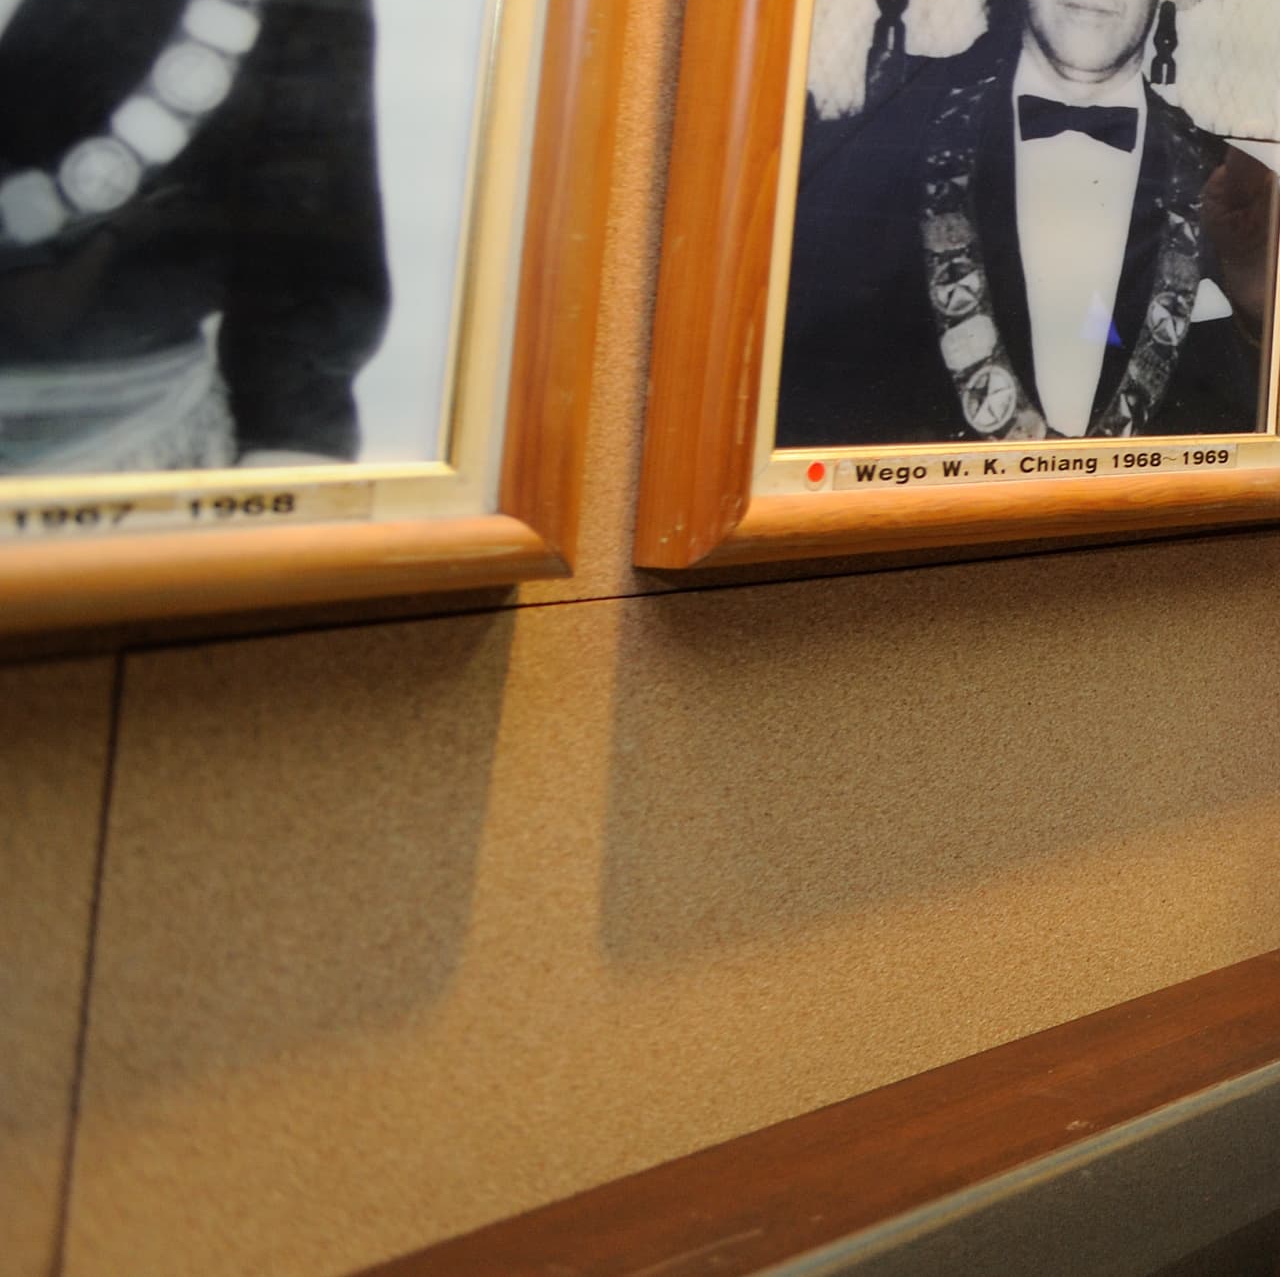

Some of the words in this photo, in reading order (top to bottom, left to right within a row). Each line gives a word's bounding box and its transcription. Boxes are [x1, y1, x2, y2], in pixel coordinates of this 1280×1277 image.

[856, 463, 927, 485] Wego
[943, 460, 969, 477] W.
[984, 458, 1006, 475] K.
[1020, 455, 1098, 474] Chiang
[190, 491, 296, 519] 1968
